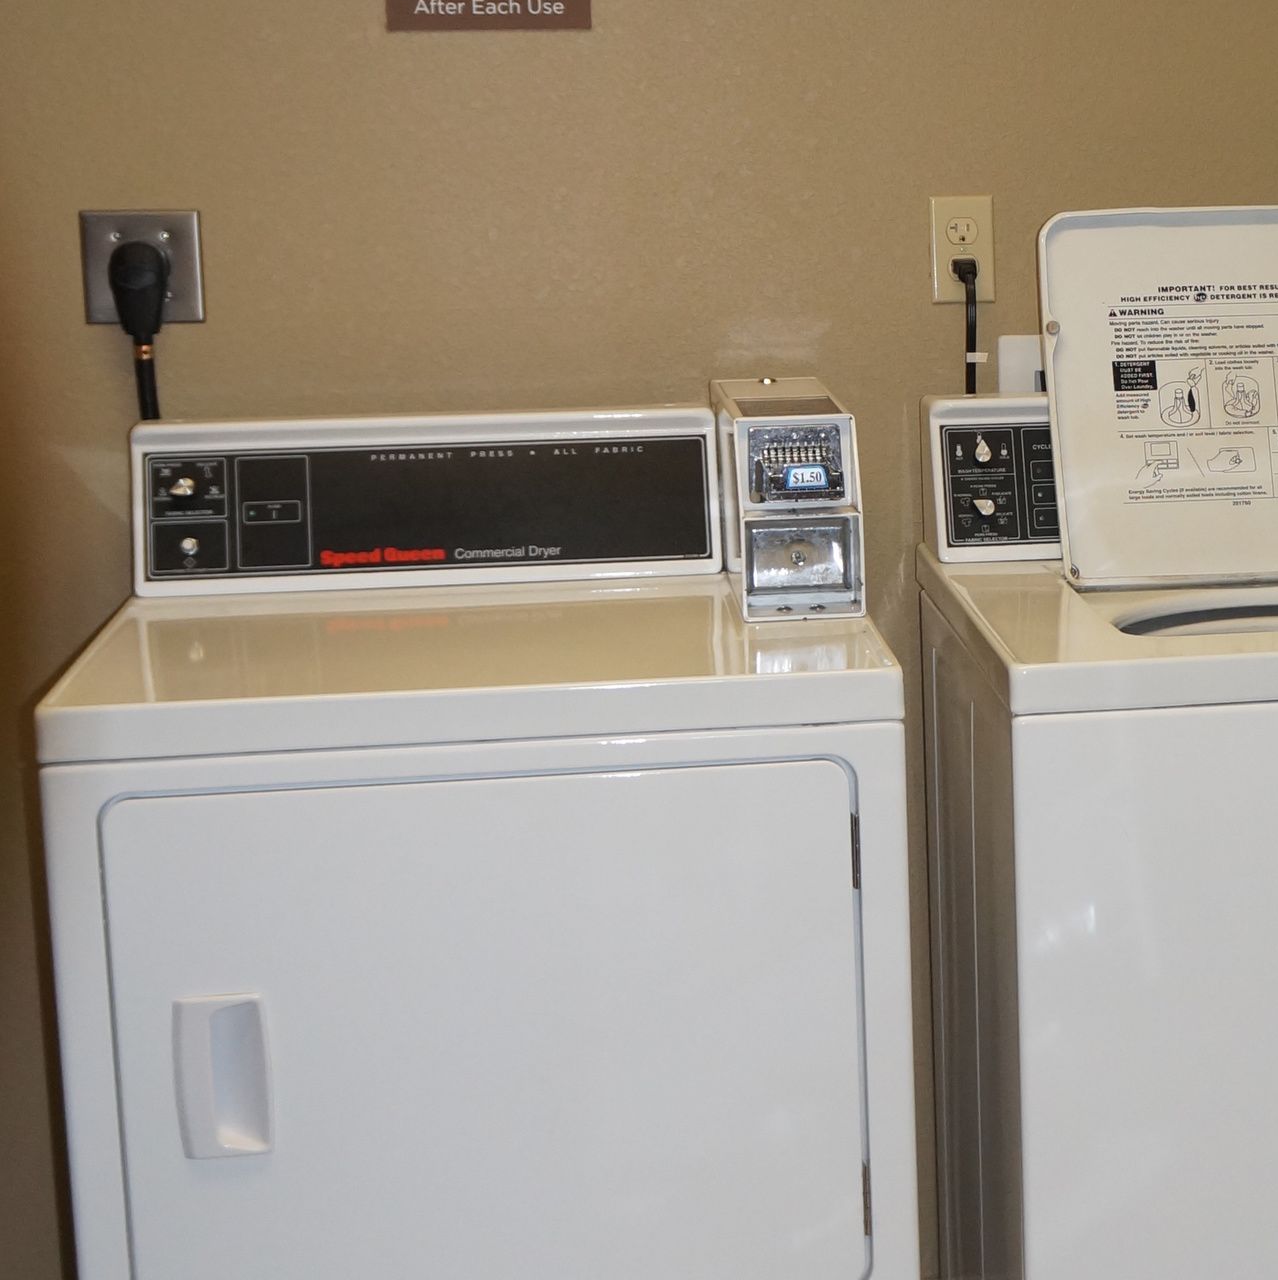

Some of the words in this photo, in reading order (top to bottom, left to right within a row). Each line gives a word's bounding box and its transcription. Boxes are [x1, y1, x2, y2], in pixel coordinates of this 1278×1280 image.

[414, 0, 465, 14] After
[472, 0, 520, 14] Each
[527, 0, 565, 14] Use
[1158, 285, 1215, 293] IMPORTANT!
[1119, 308, 1164, 317] WARNING
[370, 451, 453, 461] PERMANENT
[470, 450, 514, 458] PRESS
[594, 446, 644, 454] FABRIC
[792, 472, 822, 484] $1.50
[320, 548, 381, 567] Speed
[383, 547, 446, 562] Queen
[454, 545, 525, 559] Commercial
[528, 545, 562, 558] Dryer
